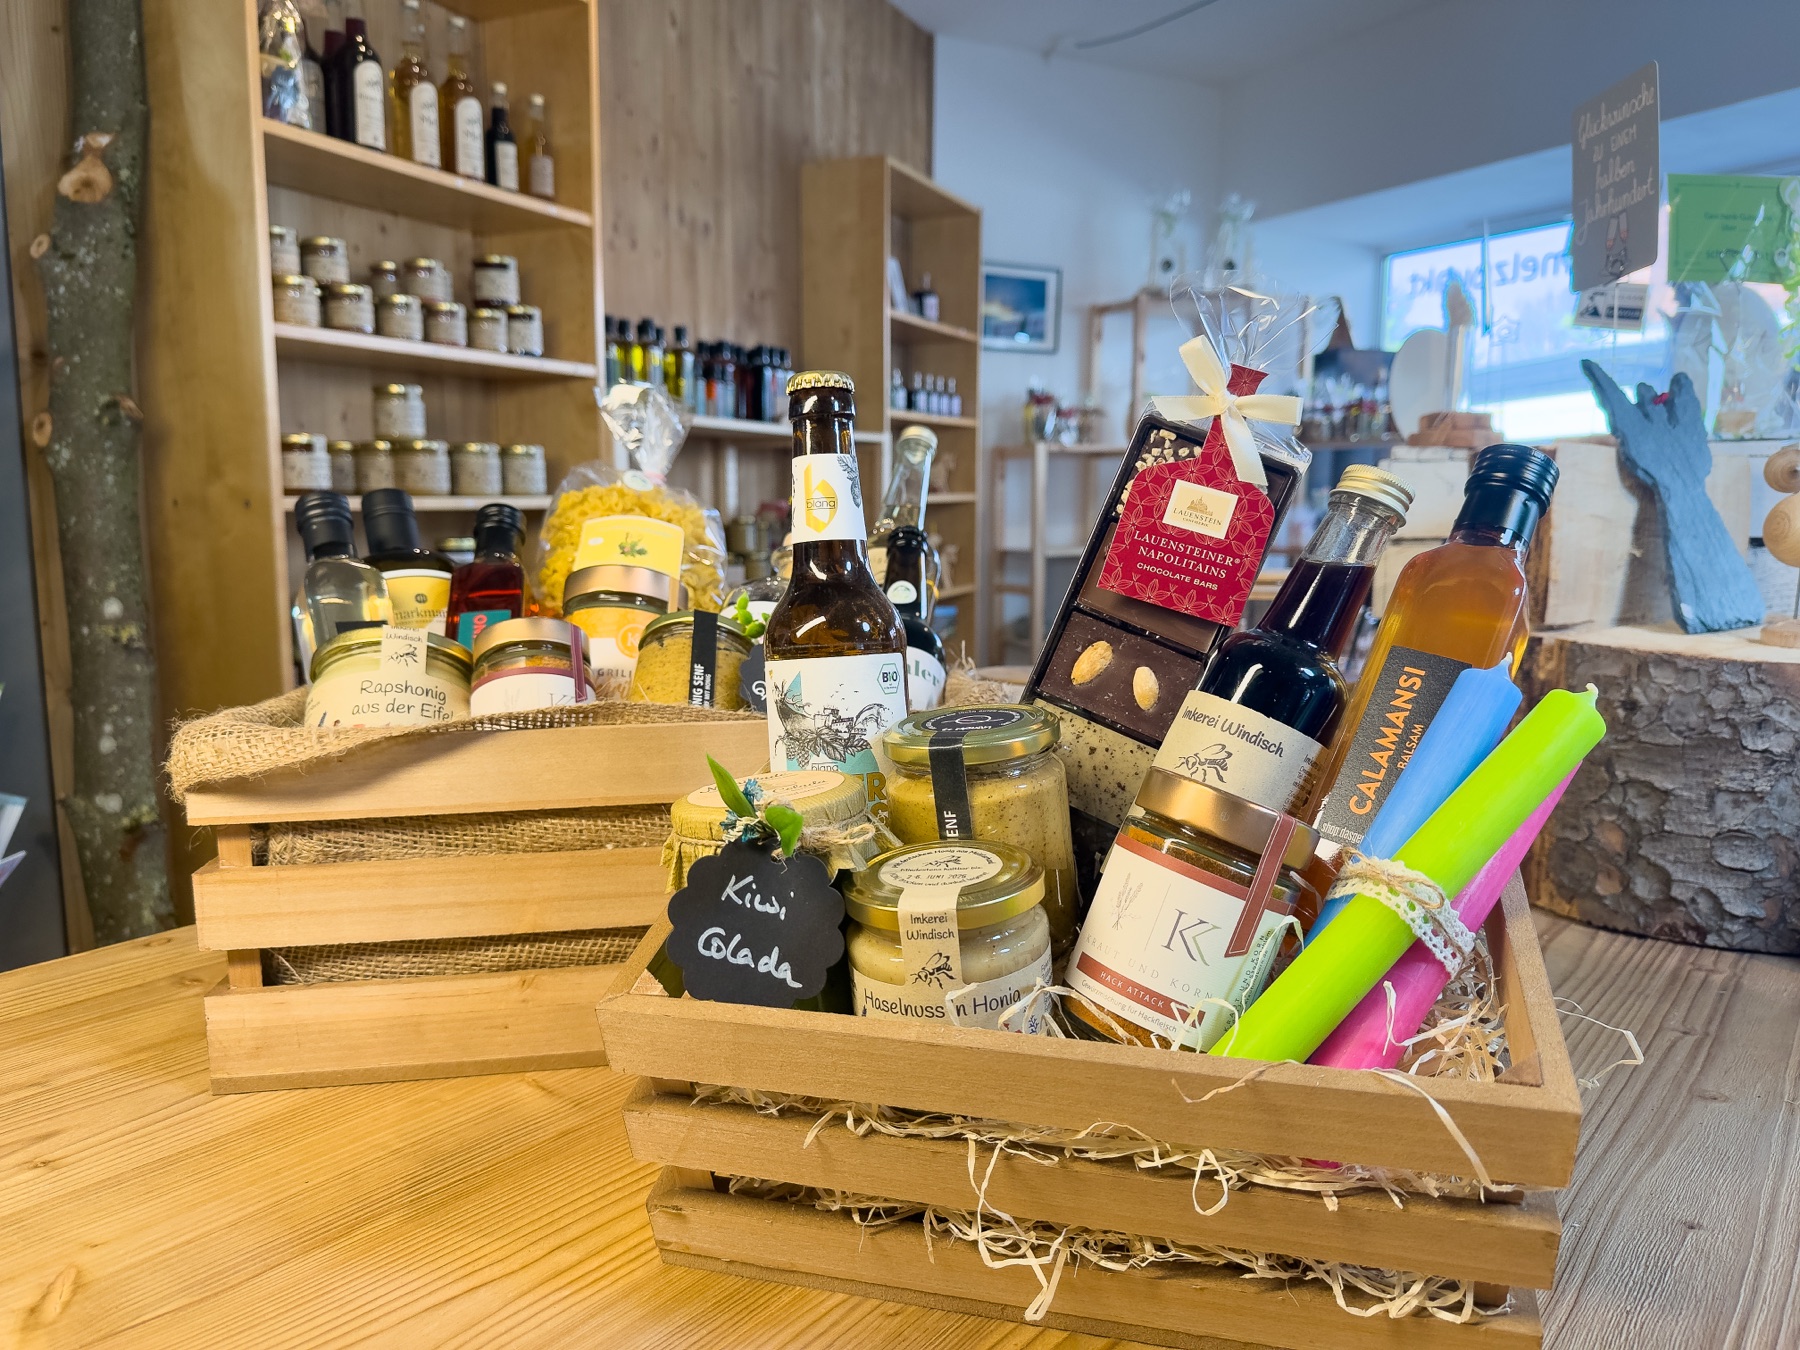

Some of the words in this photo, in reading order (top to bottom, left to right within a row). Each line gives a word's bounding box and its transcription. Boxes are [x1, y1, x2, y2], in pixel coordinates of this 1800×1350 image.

[1173, 507, 1222, 526] LAUENSTEIN
[1136, 562, 1191, 583] CHOCOLATE
[1193, 578, 1219, 591] BARS
[1138, 546, 1227, 579] NAPOLITAINS
[693, 663, 705, 687] SENF
[352, 702, 380, 716] aus
[386, 698, 415, 715] der
[360, 680, 447, 706] Rapshonig
[1182, 706, 1221, 729] Imkerei
[1220, 718, 1284, 758] Windisch
[1349, 666, 1426, 815] CALAMANSI
[1396, 724, 1424, 770] BALSAM
[944, 810, 959, 838] ENF
[721, 874, 795, 921] Kiwi
[910, 912, 948, 925] Imkerei
[906, 928, 955, 941] Windisch
[697, 926, 803, 988] Colada
[1085, 933, 1120, 960] KRAUT
[1128, 957, 1159, 980] UND
[864, 988, 946, 1018] Haselnuss
[1100, 971, 1123, 989] HACK
[1126, 985, 1165, 1009] ATTACK
[1081, 979, 1126, 1012] Gewürzmischung
[1127, 1005, 1138, 1016] für
[1138, 1010, 1177, 1033] Hackfleisch
